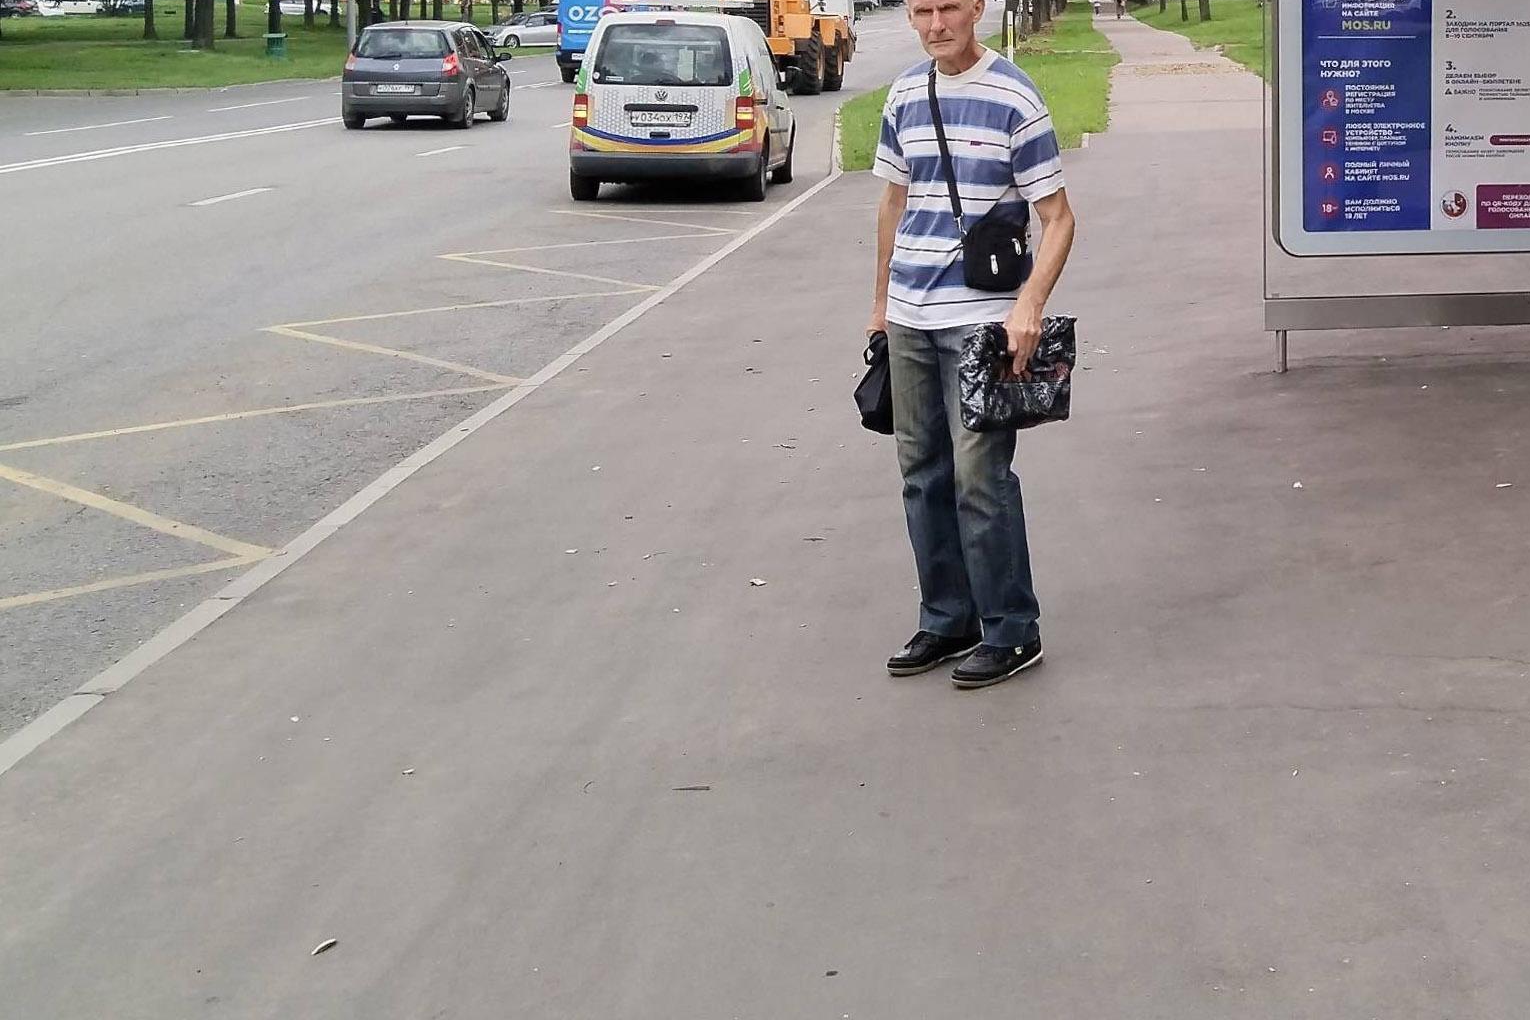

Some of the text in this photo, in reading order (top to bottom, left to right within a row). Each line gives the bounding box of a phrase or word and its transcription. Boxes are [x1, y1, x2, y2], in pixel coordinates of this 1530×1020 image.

[1354, 9, 1379, 17] САЙТЕ
[1446, 10, 1457, 19] 2.
[1342, 21, 1391, 30] MOS.RU
[1340, 61, 1360, 69] ДЛЯ
[1446, 61, 1456, 70] 3.
[1445, 124, 1457, 133] 4.
